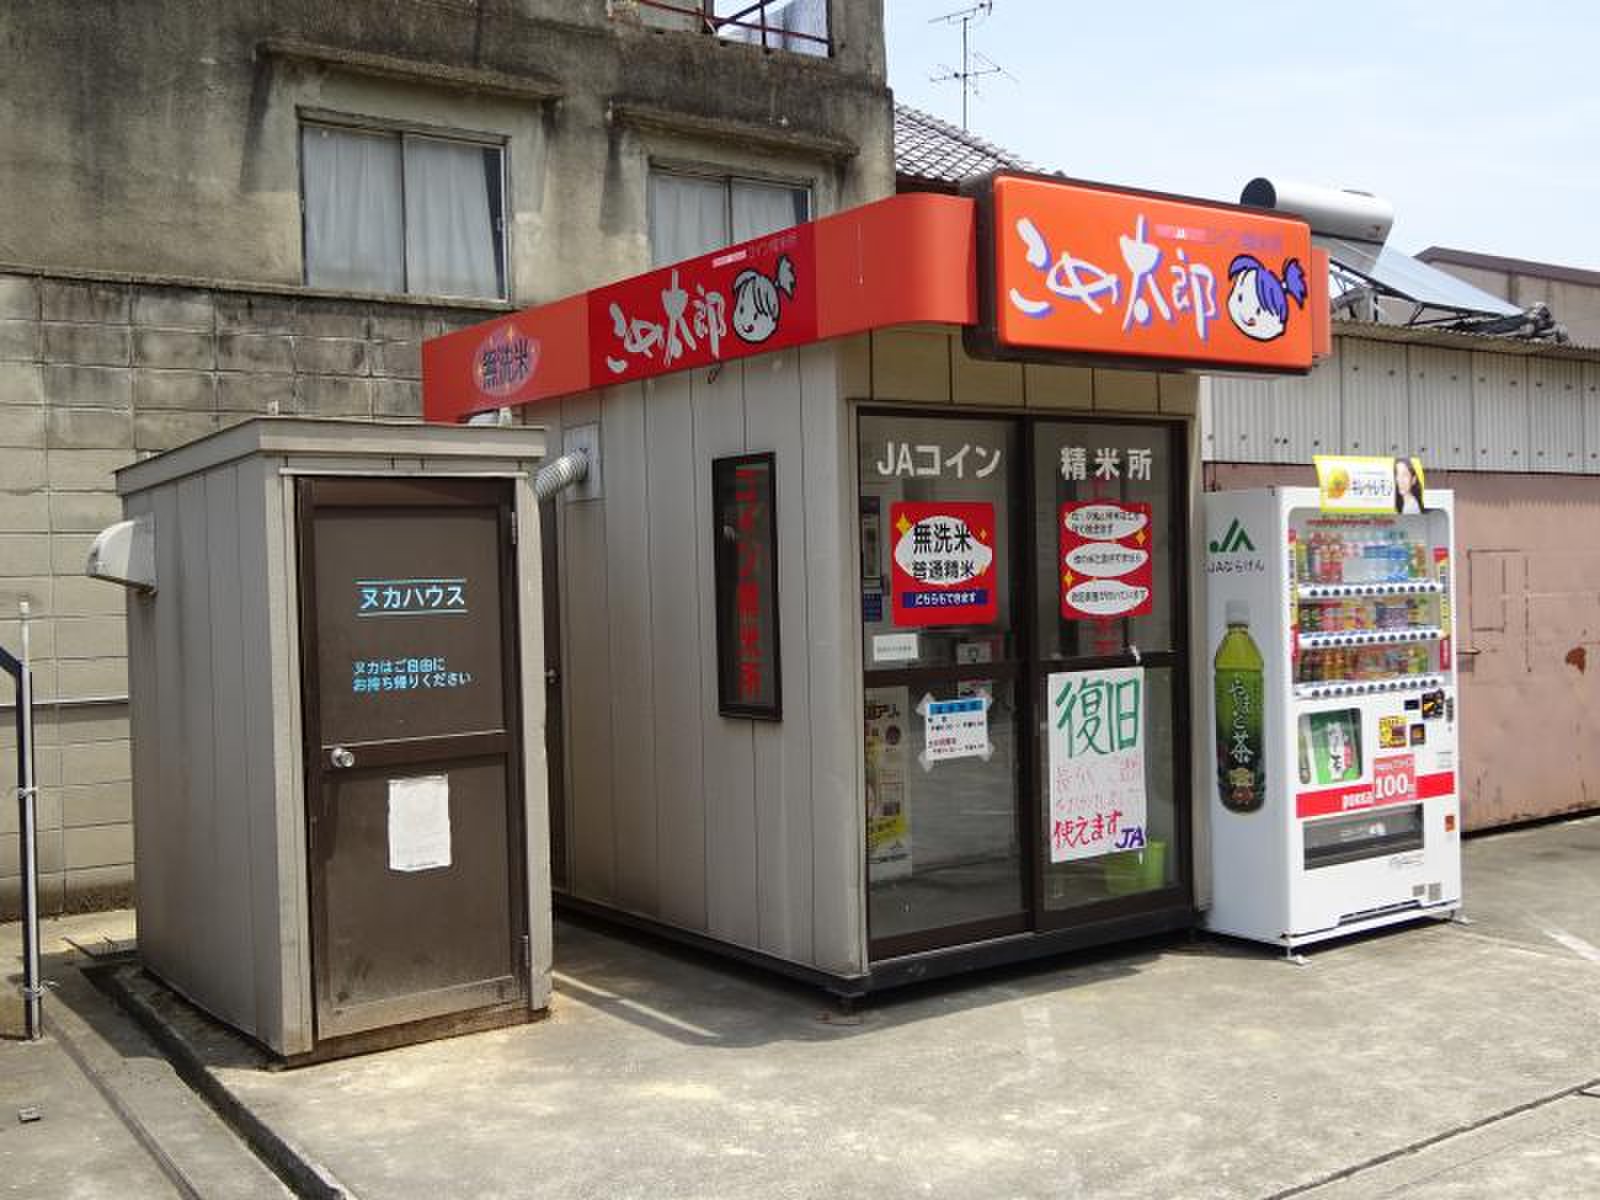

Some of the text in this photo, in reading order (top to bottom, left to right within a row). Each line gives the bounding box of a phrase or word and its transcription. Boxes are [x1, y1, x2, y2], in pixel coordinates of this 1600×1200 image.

[1010, 213, 1219, 341] こめ太郎
[607, 270, 726, 373] こめ太郎
[877, 441, 1153, 481] JAコイン 精米所
[912, 521, 973, 553] 無洗米
[359, 584, 465, 609] ヌカハウス
[353, 657, 446, 673] ヌカはご自由に
[353, 672, 471, 691] お持ち帰りください
[1055, 677, 1140, 759] 復旧
[1375, 773, 1408, 799] 100
[1055, 809, 1122, 849] 使えます
[1115, 826, 1145, 849] JA
